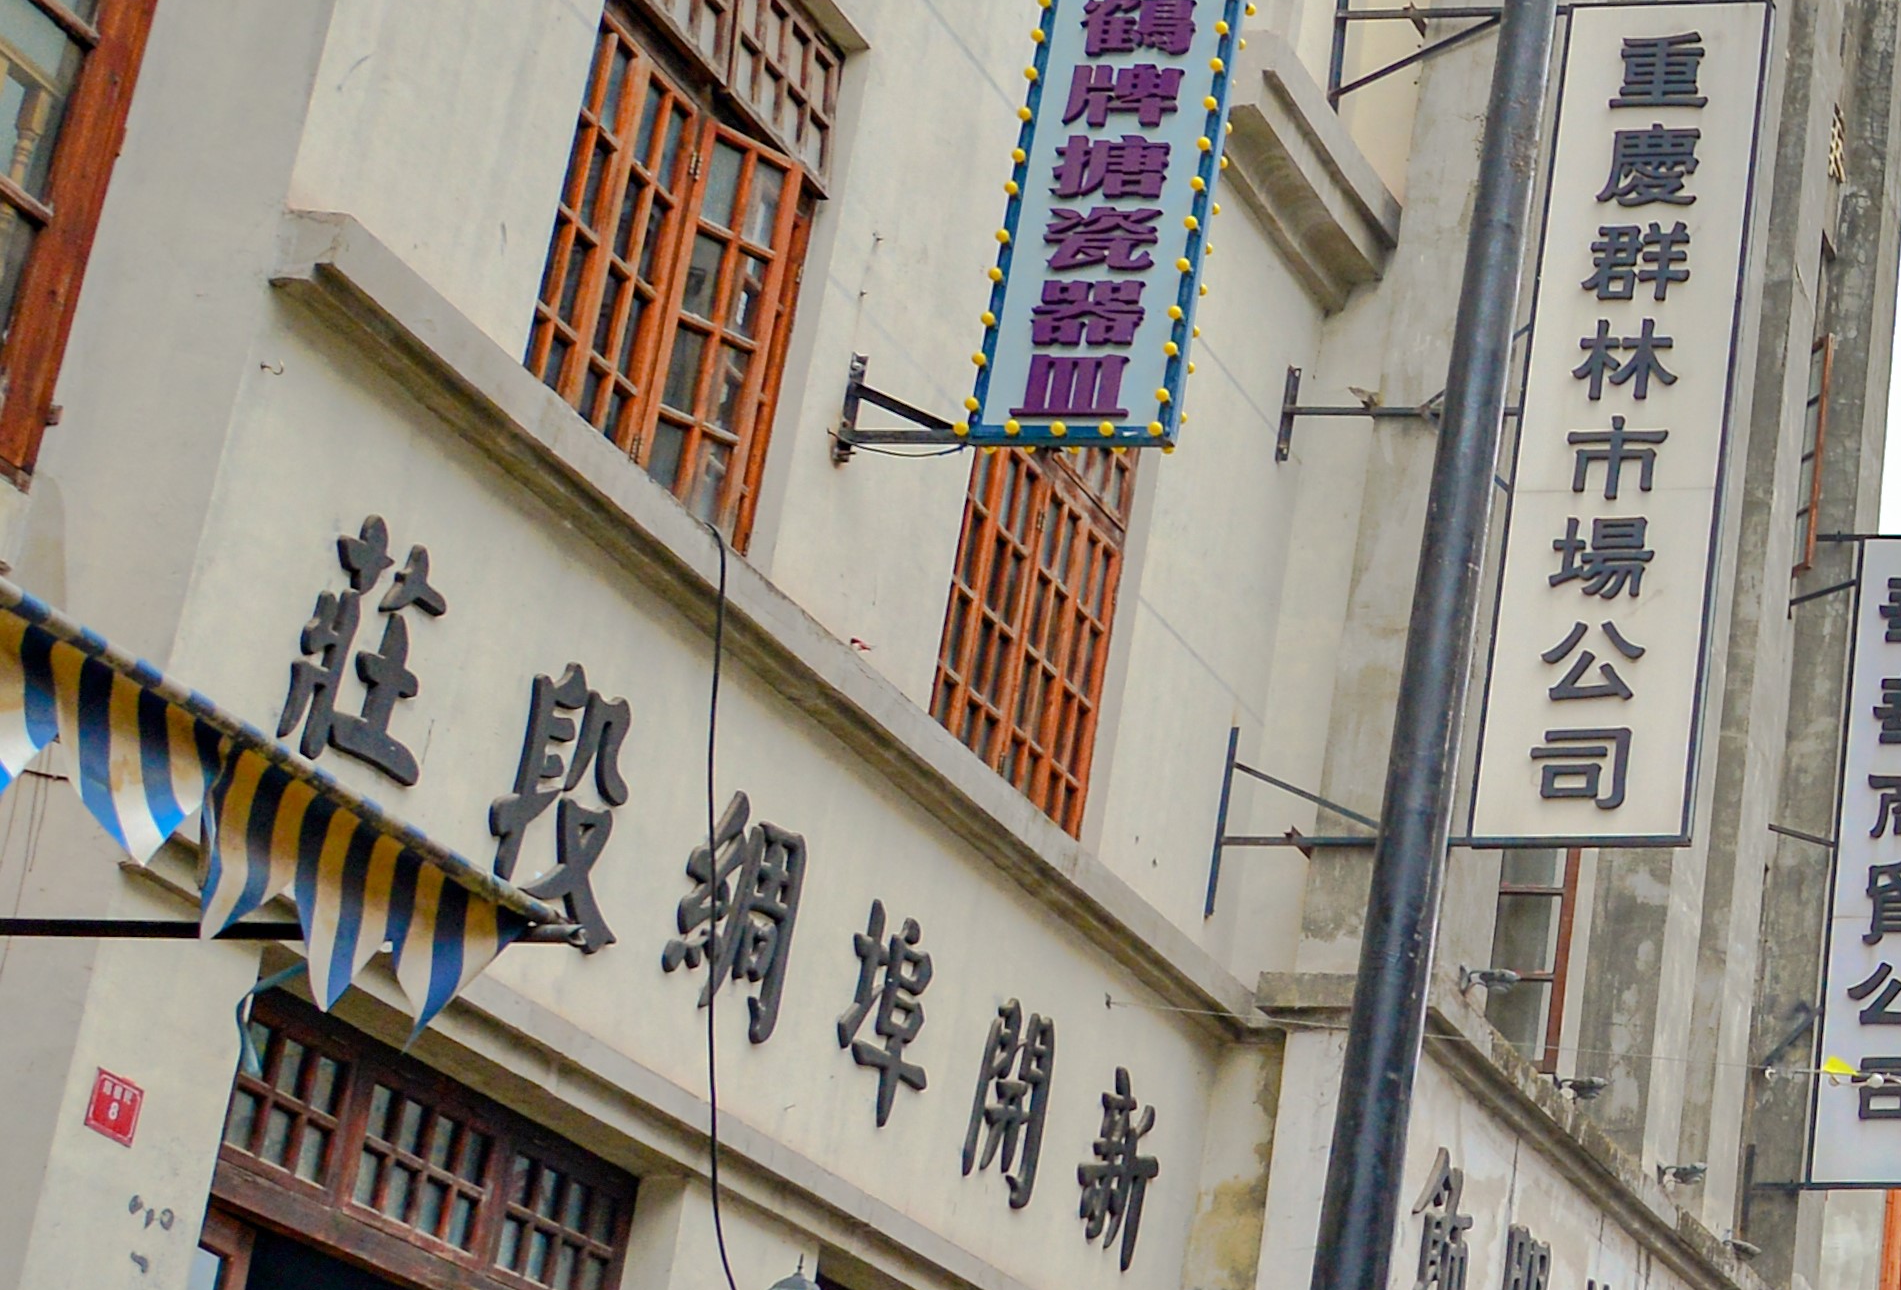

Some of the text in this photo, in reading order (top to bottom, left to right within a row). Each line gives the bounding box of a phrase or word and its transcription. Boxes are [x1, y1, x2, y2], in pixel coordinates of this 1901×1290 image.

[1529, 30, 1709, 811] 重慶群林市場公司
